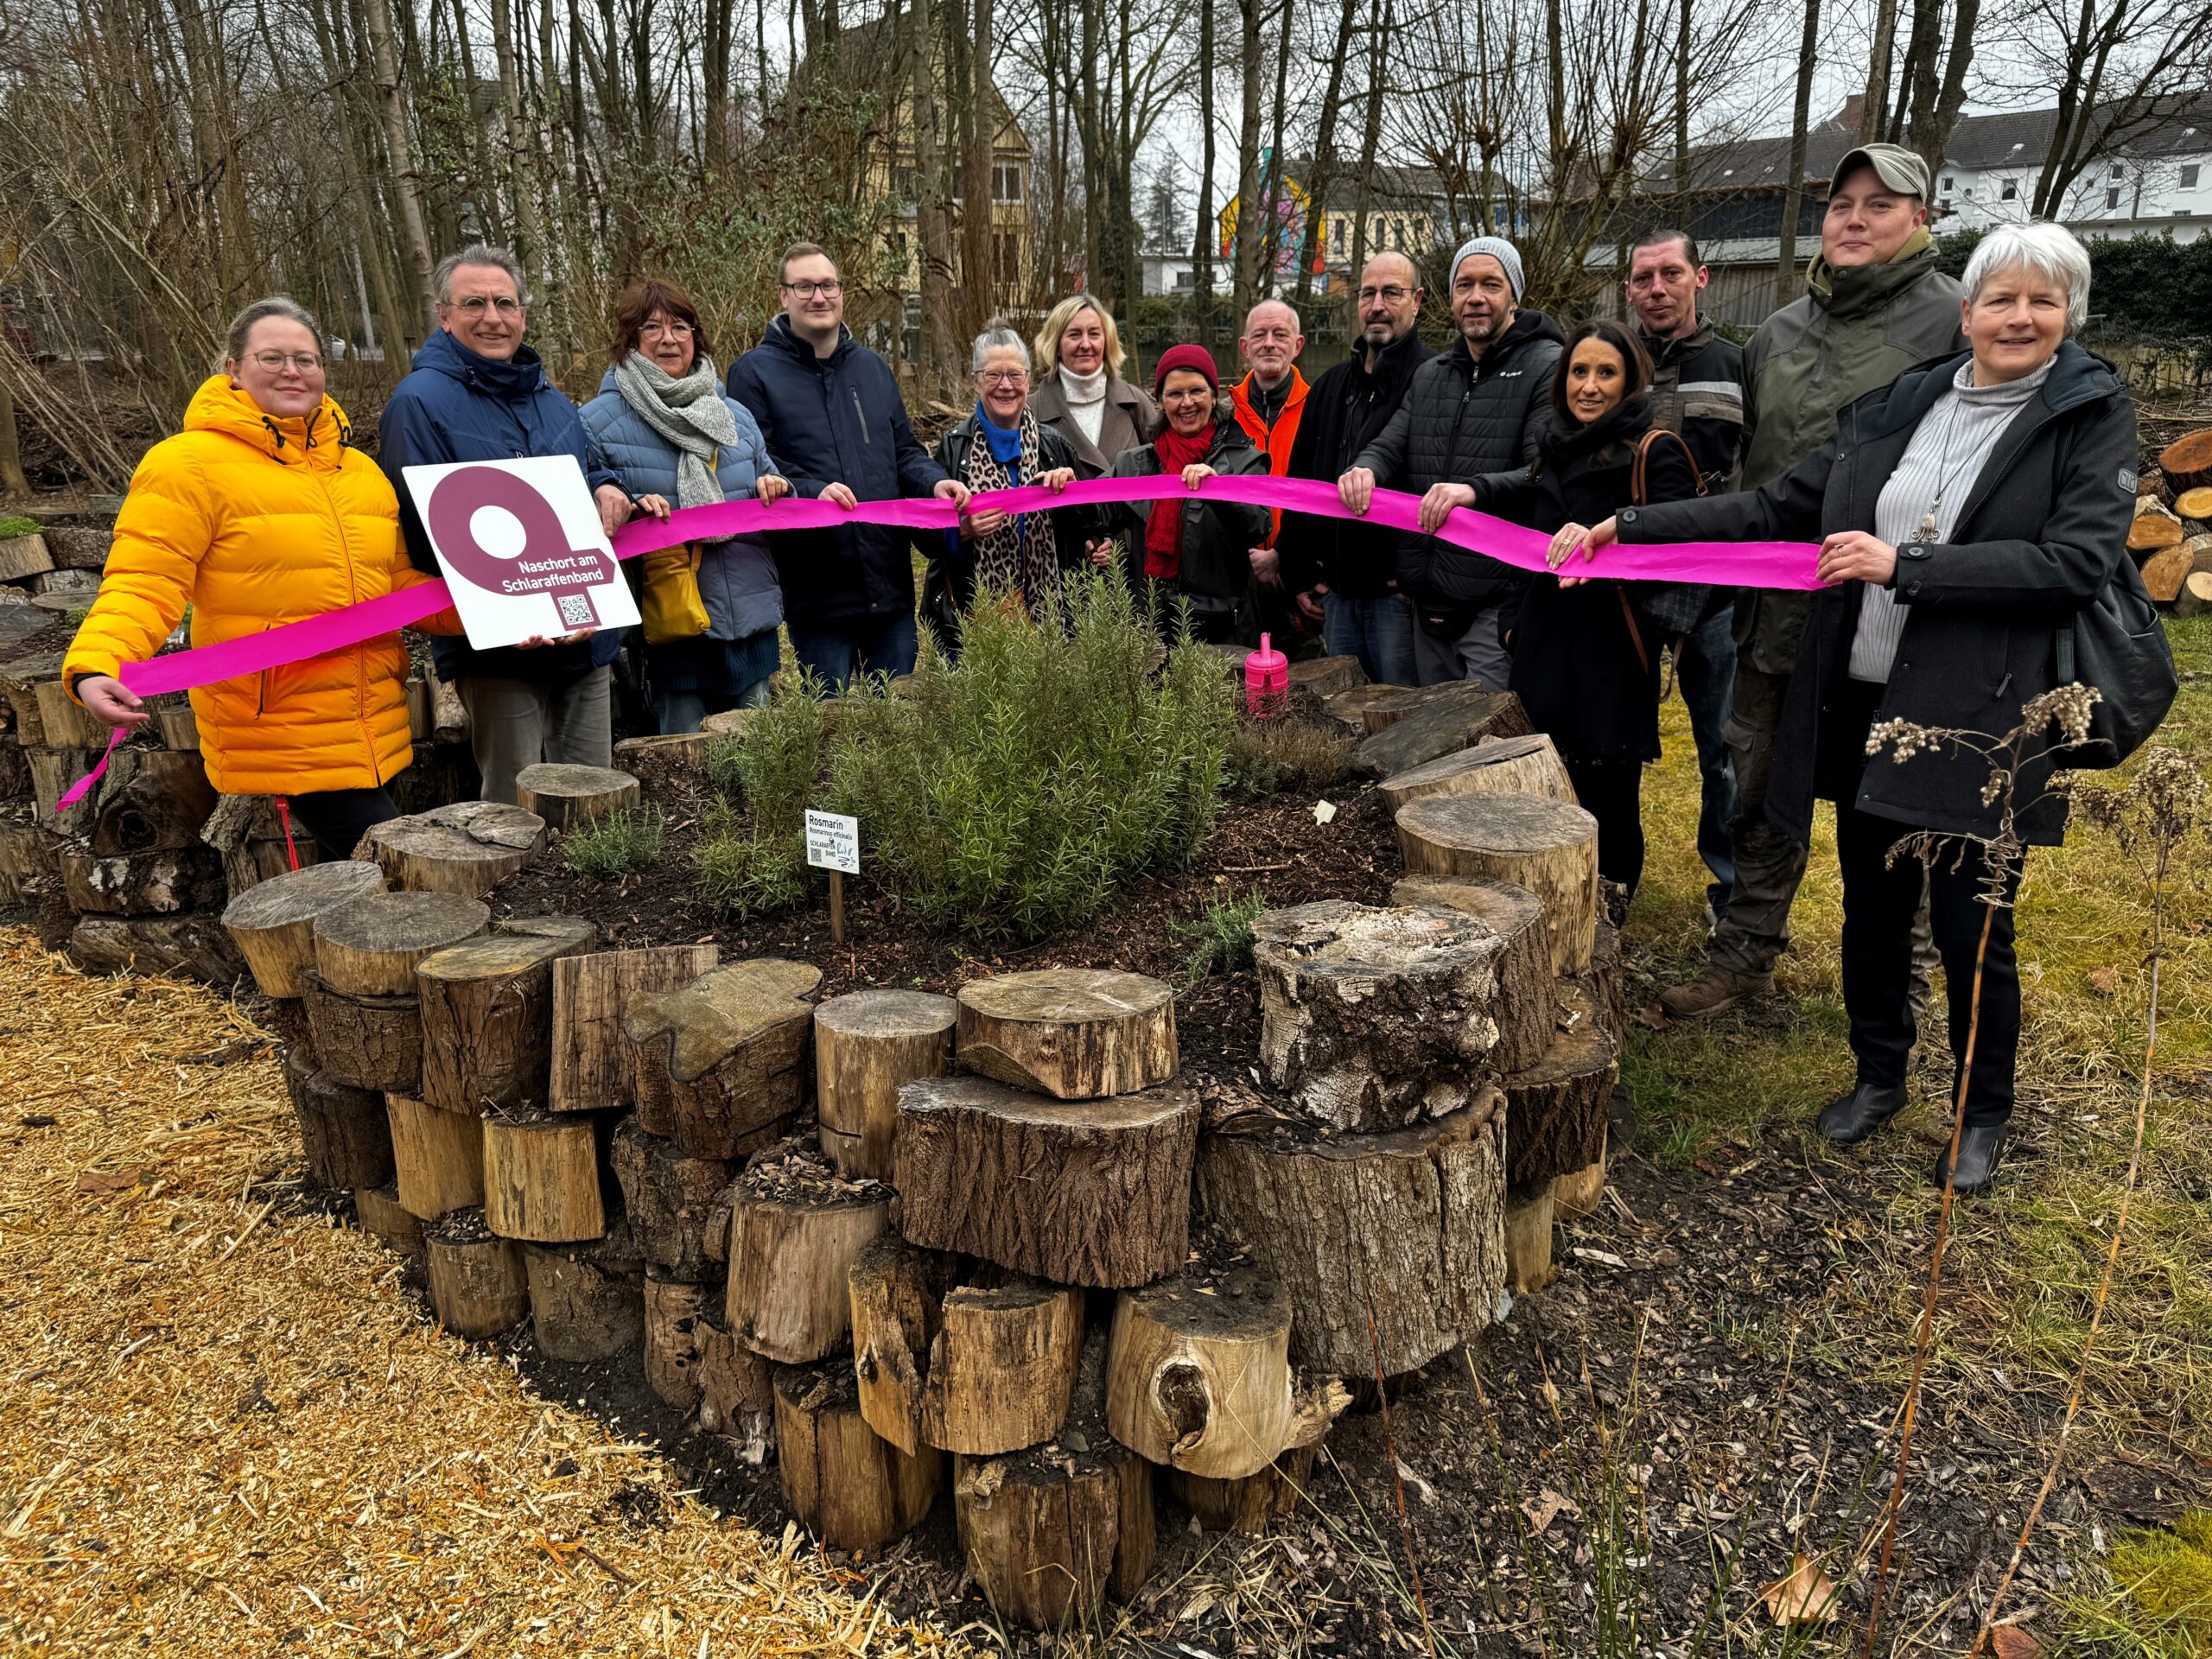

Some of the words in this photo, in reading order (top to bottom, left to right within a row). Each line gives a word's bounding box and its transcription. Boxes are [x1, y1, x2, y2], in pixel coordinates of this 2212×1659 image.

[518, 557, 576, 574] Naschort
[579, 556, 598, 567] am
[502, 568, 604, 593] Schlaraffenband
[809, 815, 843, 830] Rosmarin
[810, 827, 833, 836] Rosmarinus
